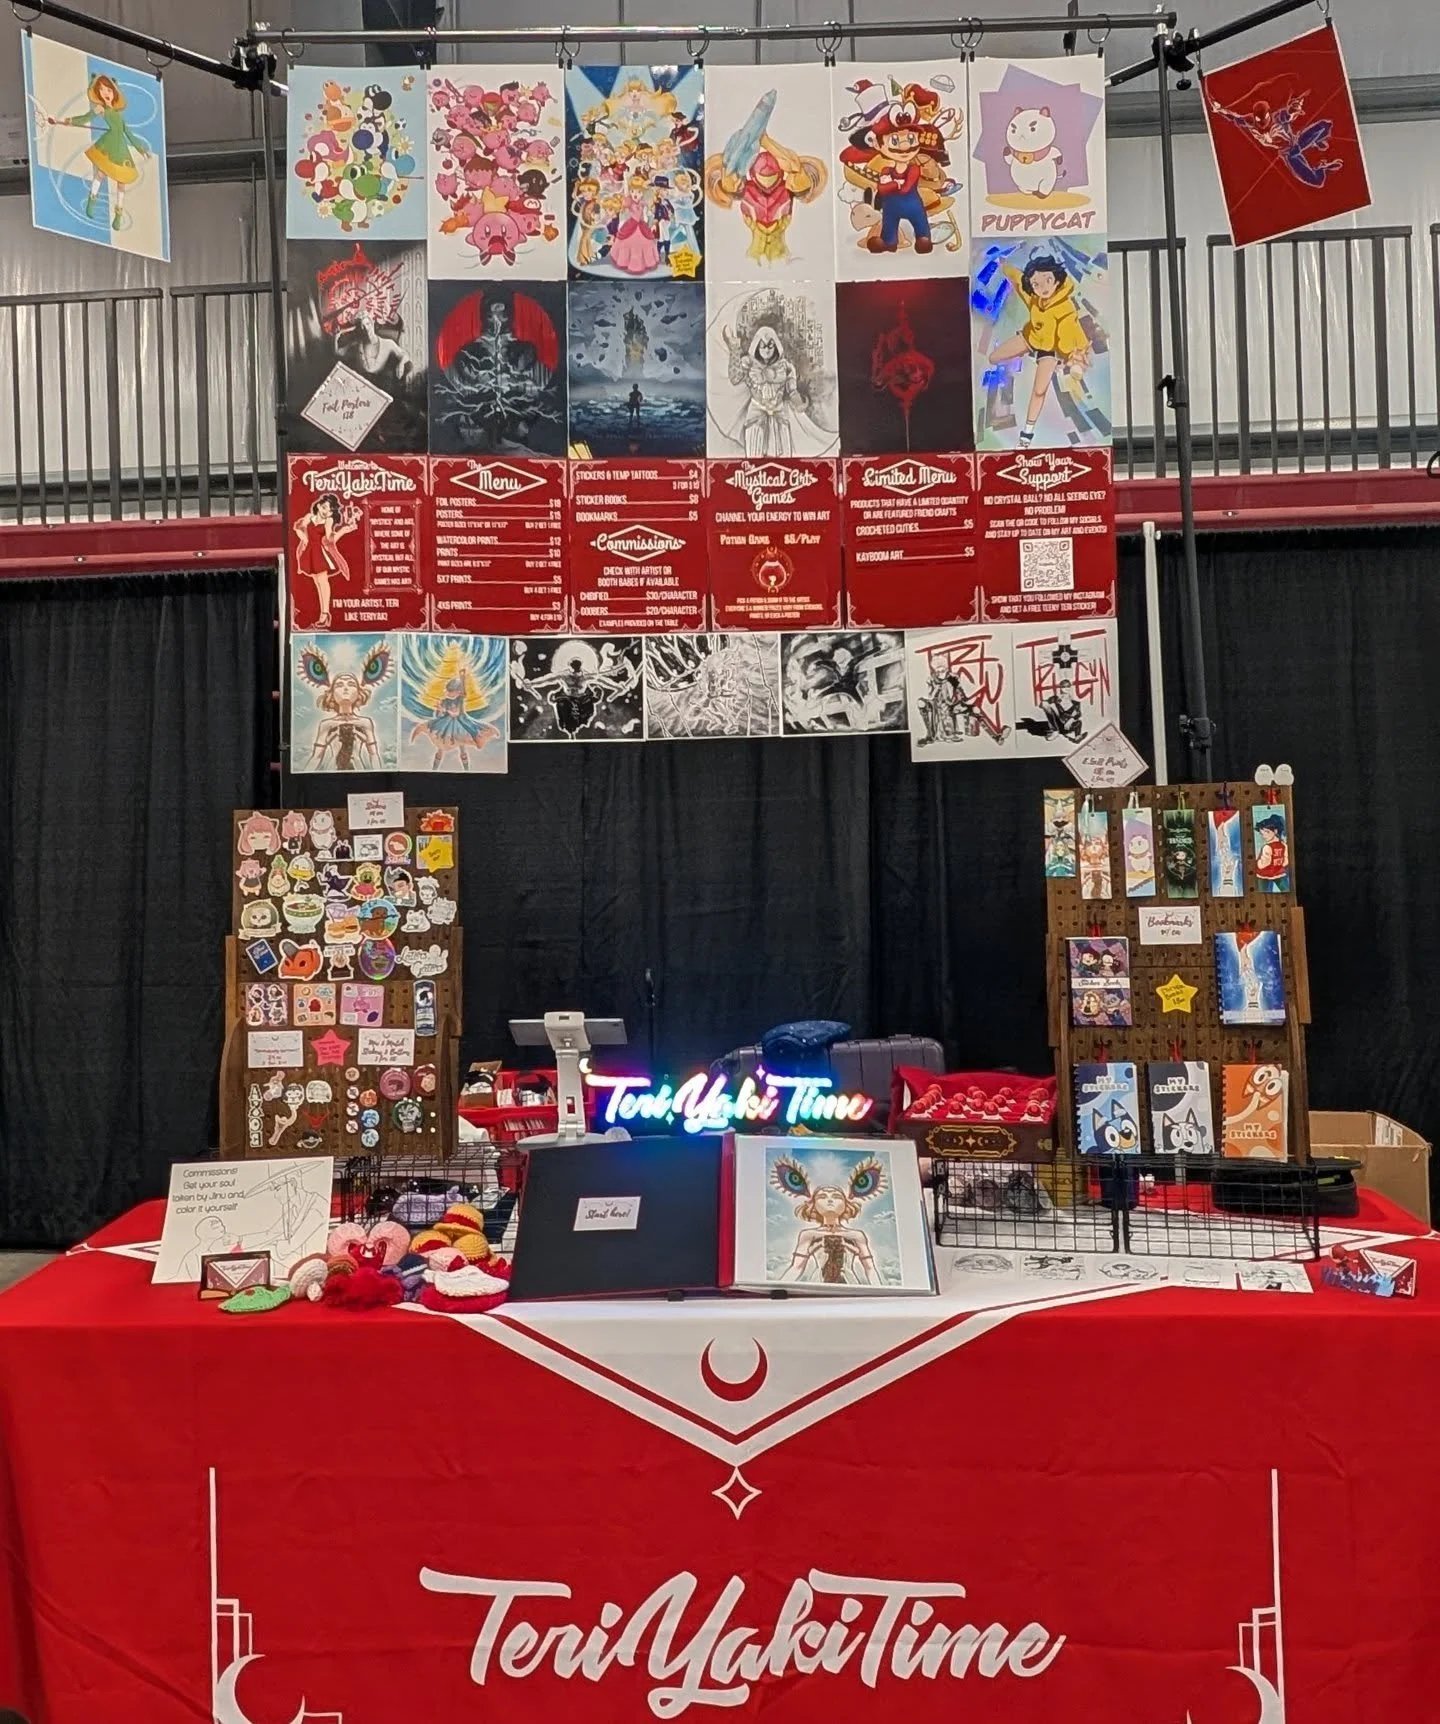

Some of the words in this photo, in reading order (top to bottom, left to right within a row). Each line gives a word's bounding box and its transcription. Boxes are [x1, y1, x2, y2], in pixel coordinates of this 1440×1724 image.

[982, 211, 1096, 233] PUPPYCAT
[1015, 454, 1042, 468] Show
[1045, 453, 1074, 471] Your
[576, 470, 605, 480] STICKERS
[612, 470, 630, 480] TEMP
[631, 470, 658, 480] TATTOOS
[862, 468, 916, 488] Limited
[918, 466, 957, 484] Menu
[479, 470, 522, 491] Menu
[734, 470, 787, 494] Mystical
[790, 469, 814, 488] Art
[1019, 470, 1072, 492] Support
[436, 497, 448, 506] FOIL
[450, 497, 477, 506] POSTERS
[576, 495, 604, 505] STICKER
[605, 495, 627, 505] BOOKS
[752, 491, 796, 510] Games
[994, 495, 1021, 504] CRYSTAL
[1023, 494, 1043, 503] BALL?
[1044, 493, 1052, 502] NO
[1053, 493, 1065, 502] ALL
[436, 510, 464, 519] POSTERS
[576, 512, 618, 522] BOOKMARKS
[716, 512, 746, 523] CHANNEL
[747, 512, 765, 522] YOUR
[766, 512, 792, 522] ENERGY
[793, 512, 802, 522] TO
[802, 512, 816, 522] WIN
[817, 511, 830, 522] ART
[856, 523, 895, 535] CROCHETED
[896, 522, 919, 534] CUTIES
[436, 536, 476, 545] WATERCOLOR
[477, 536, 499, 545] PRINTS
[596, 533, 682, 551] Commissions
[437, 548, 458, 557] PRINTS
[856, 550, 889, 561] KAYBOOM
[890, 550, 904, 561] ART
[604, 566, 623, 576] CHECK
[624, 566, 640, 576] WITH
[641, 566, 662, 576] ARTIST
[663, 566, 672, 576] OR
[450, 574, 472, 584] PRINTS
[598, 577, 618, 587] BOOTH
[619, 577, 639, 587] BABES
[646, 577, 680, 587] AVAILABLE
[451, 600, 472, 610] PRINTS
[344, 612, 359, 622] LIKE
[1096, 1076, 1113, 1085] MY
[1168, 1076, 1186, 1086] MY
[1082, 1084, 1128, 1093] STICKERS
[1153, 1084, 1200, 1094] STICKERS
[1242, 1122, 1261, 1132] MY
[1228, 1129, 1277, 1140] STICKERS
[182, 1181, 197, 1190] Get
[199, 1181, 219, 1191] your
[220, 1178, 236, 1188] soul
[173, 1192, 195, 1202] taken
[196, 1192, 208, 1203] by
[227, 1190, 244, 1199] and
[176, 1204, 196, 1214] color
[205, 1202, 239, 1213] yourself
[420, 1566, 1066, 1719] TeriYakiTime
